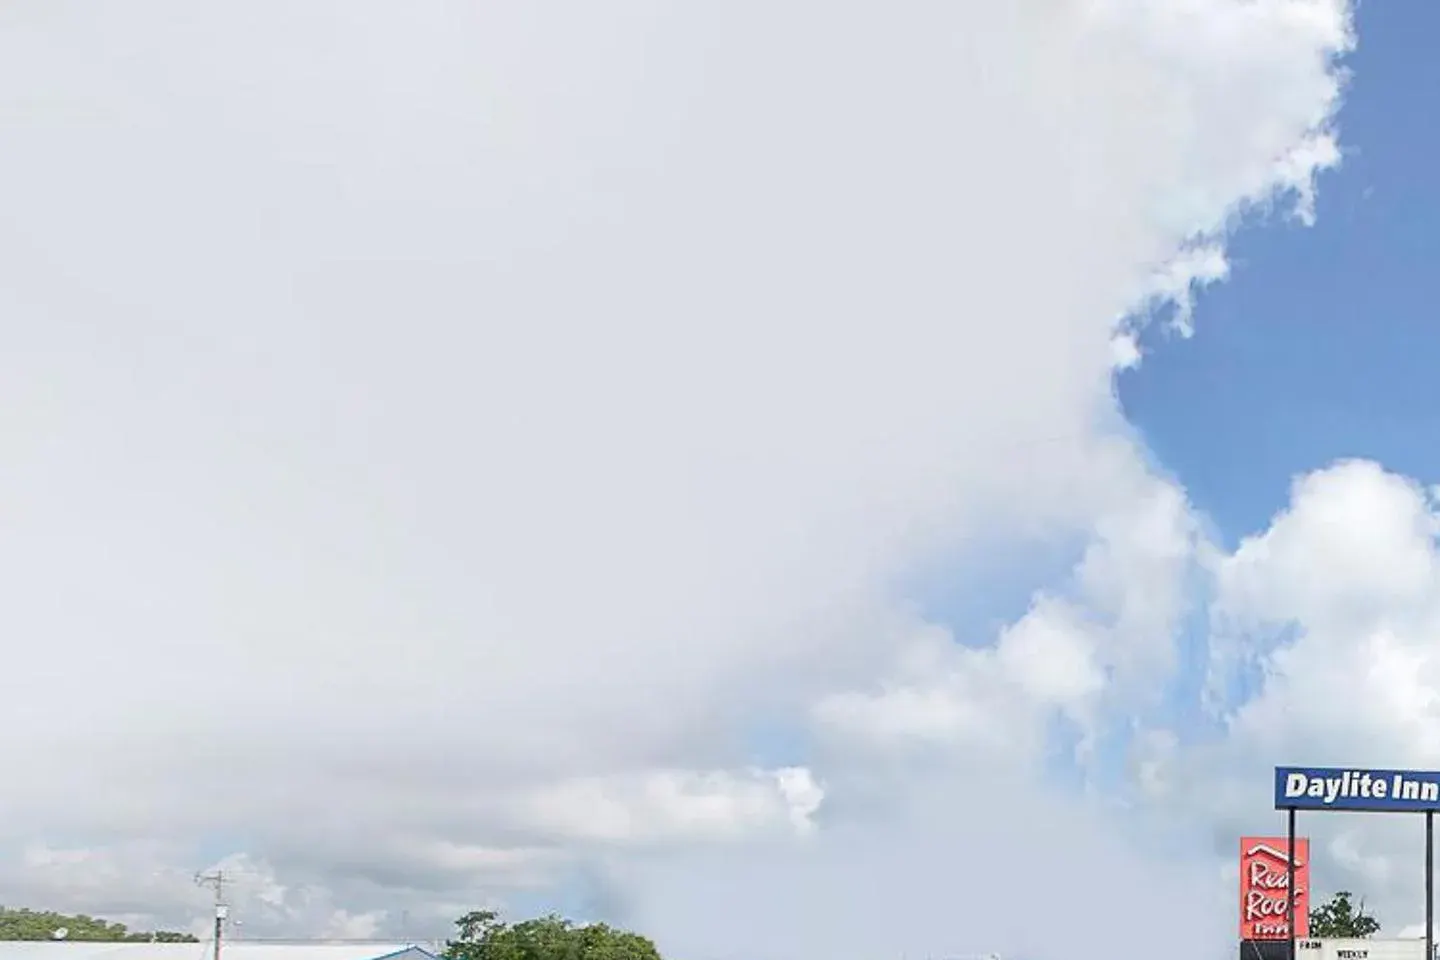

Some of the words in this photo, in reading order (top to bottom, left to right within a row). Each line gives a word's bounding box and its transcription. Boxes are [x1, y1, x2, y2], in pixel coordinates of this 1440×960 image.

[1285, 771, 1387, 803] Daylite
[1391, 775, 1439, 801] Inn
[1254, 922, 1289, 934] Inn
[1299, 941, 1322, 949] FROM
[1336, 950, 1369, 959] WEEKLY
